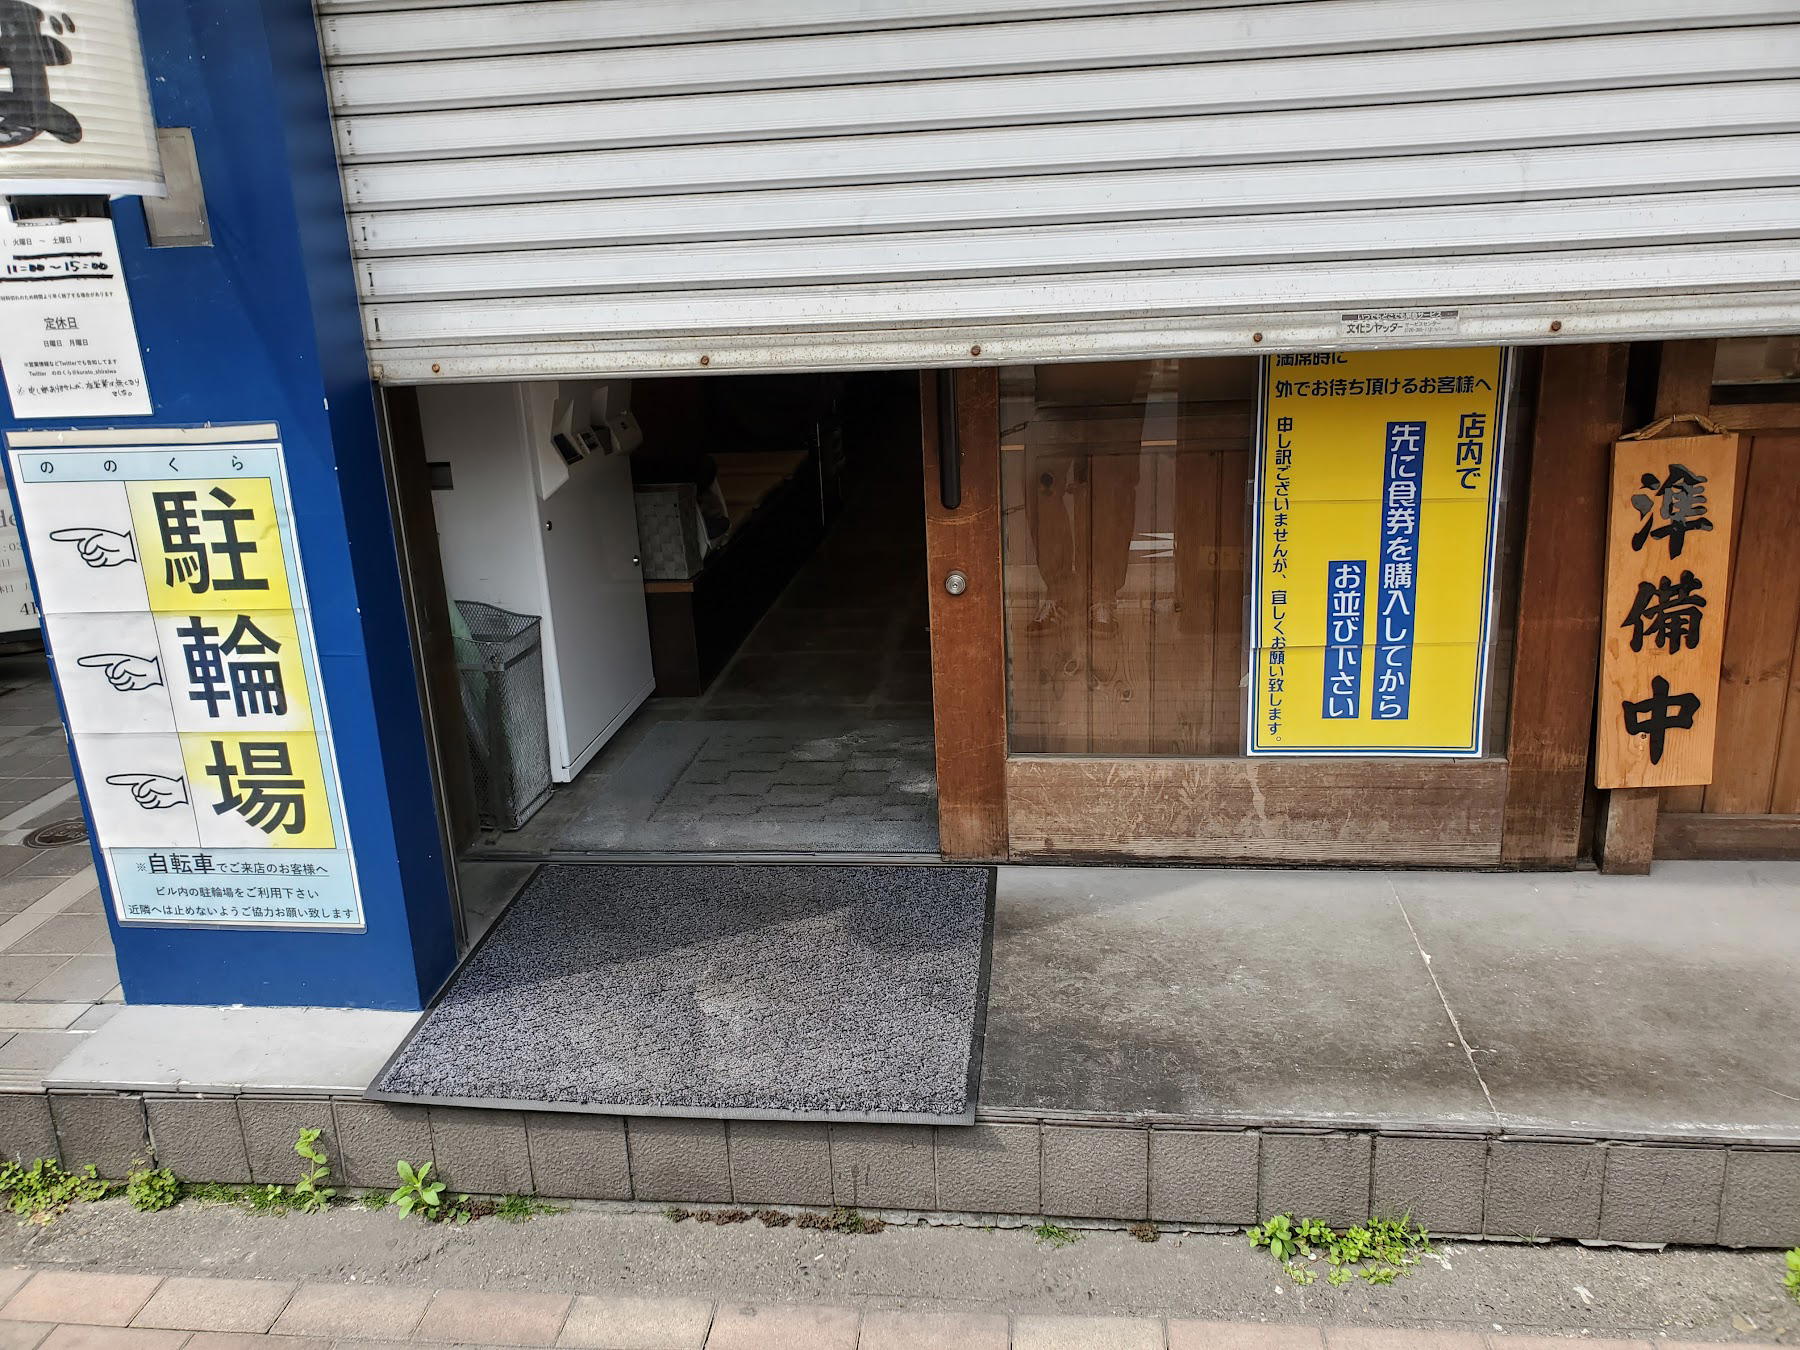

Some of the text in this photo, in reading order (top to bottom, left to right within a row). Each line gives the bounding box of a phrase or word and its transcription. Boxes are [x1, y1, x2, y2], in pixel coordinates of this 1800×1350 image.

[44, 317, 78, 330] 定休日
[43, 338, 89, 348] 日曜日 月曜日
[1275, 376, 1492, 398] 外でお待ち頂けるお客様へ
[1456, 412, 1487, 490] 店内で
[1378, 424, 1421, 719] 先に食券を購入してから
[1620, 463, 1714, 765] 準備中
[1328, 563, 1361, 718] お並び下さい
[156, 887, 319, 899] ビル内の駐輪場をご利用下さい
[128, 904, 354, 919] 近隣へは止めないようご協力お願い致します
